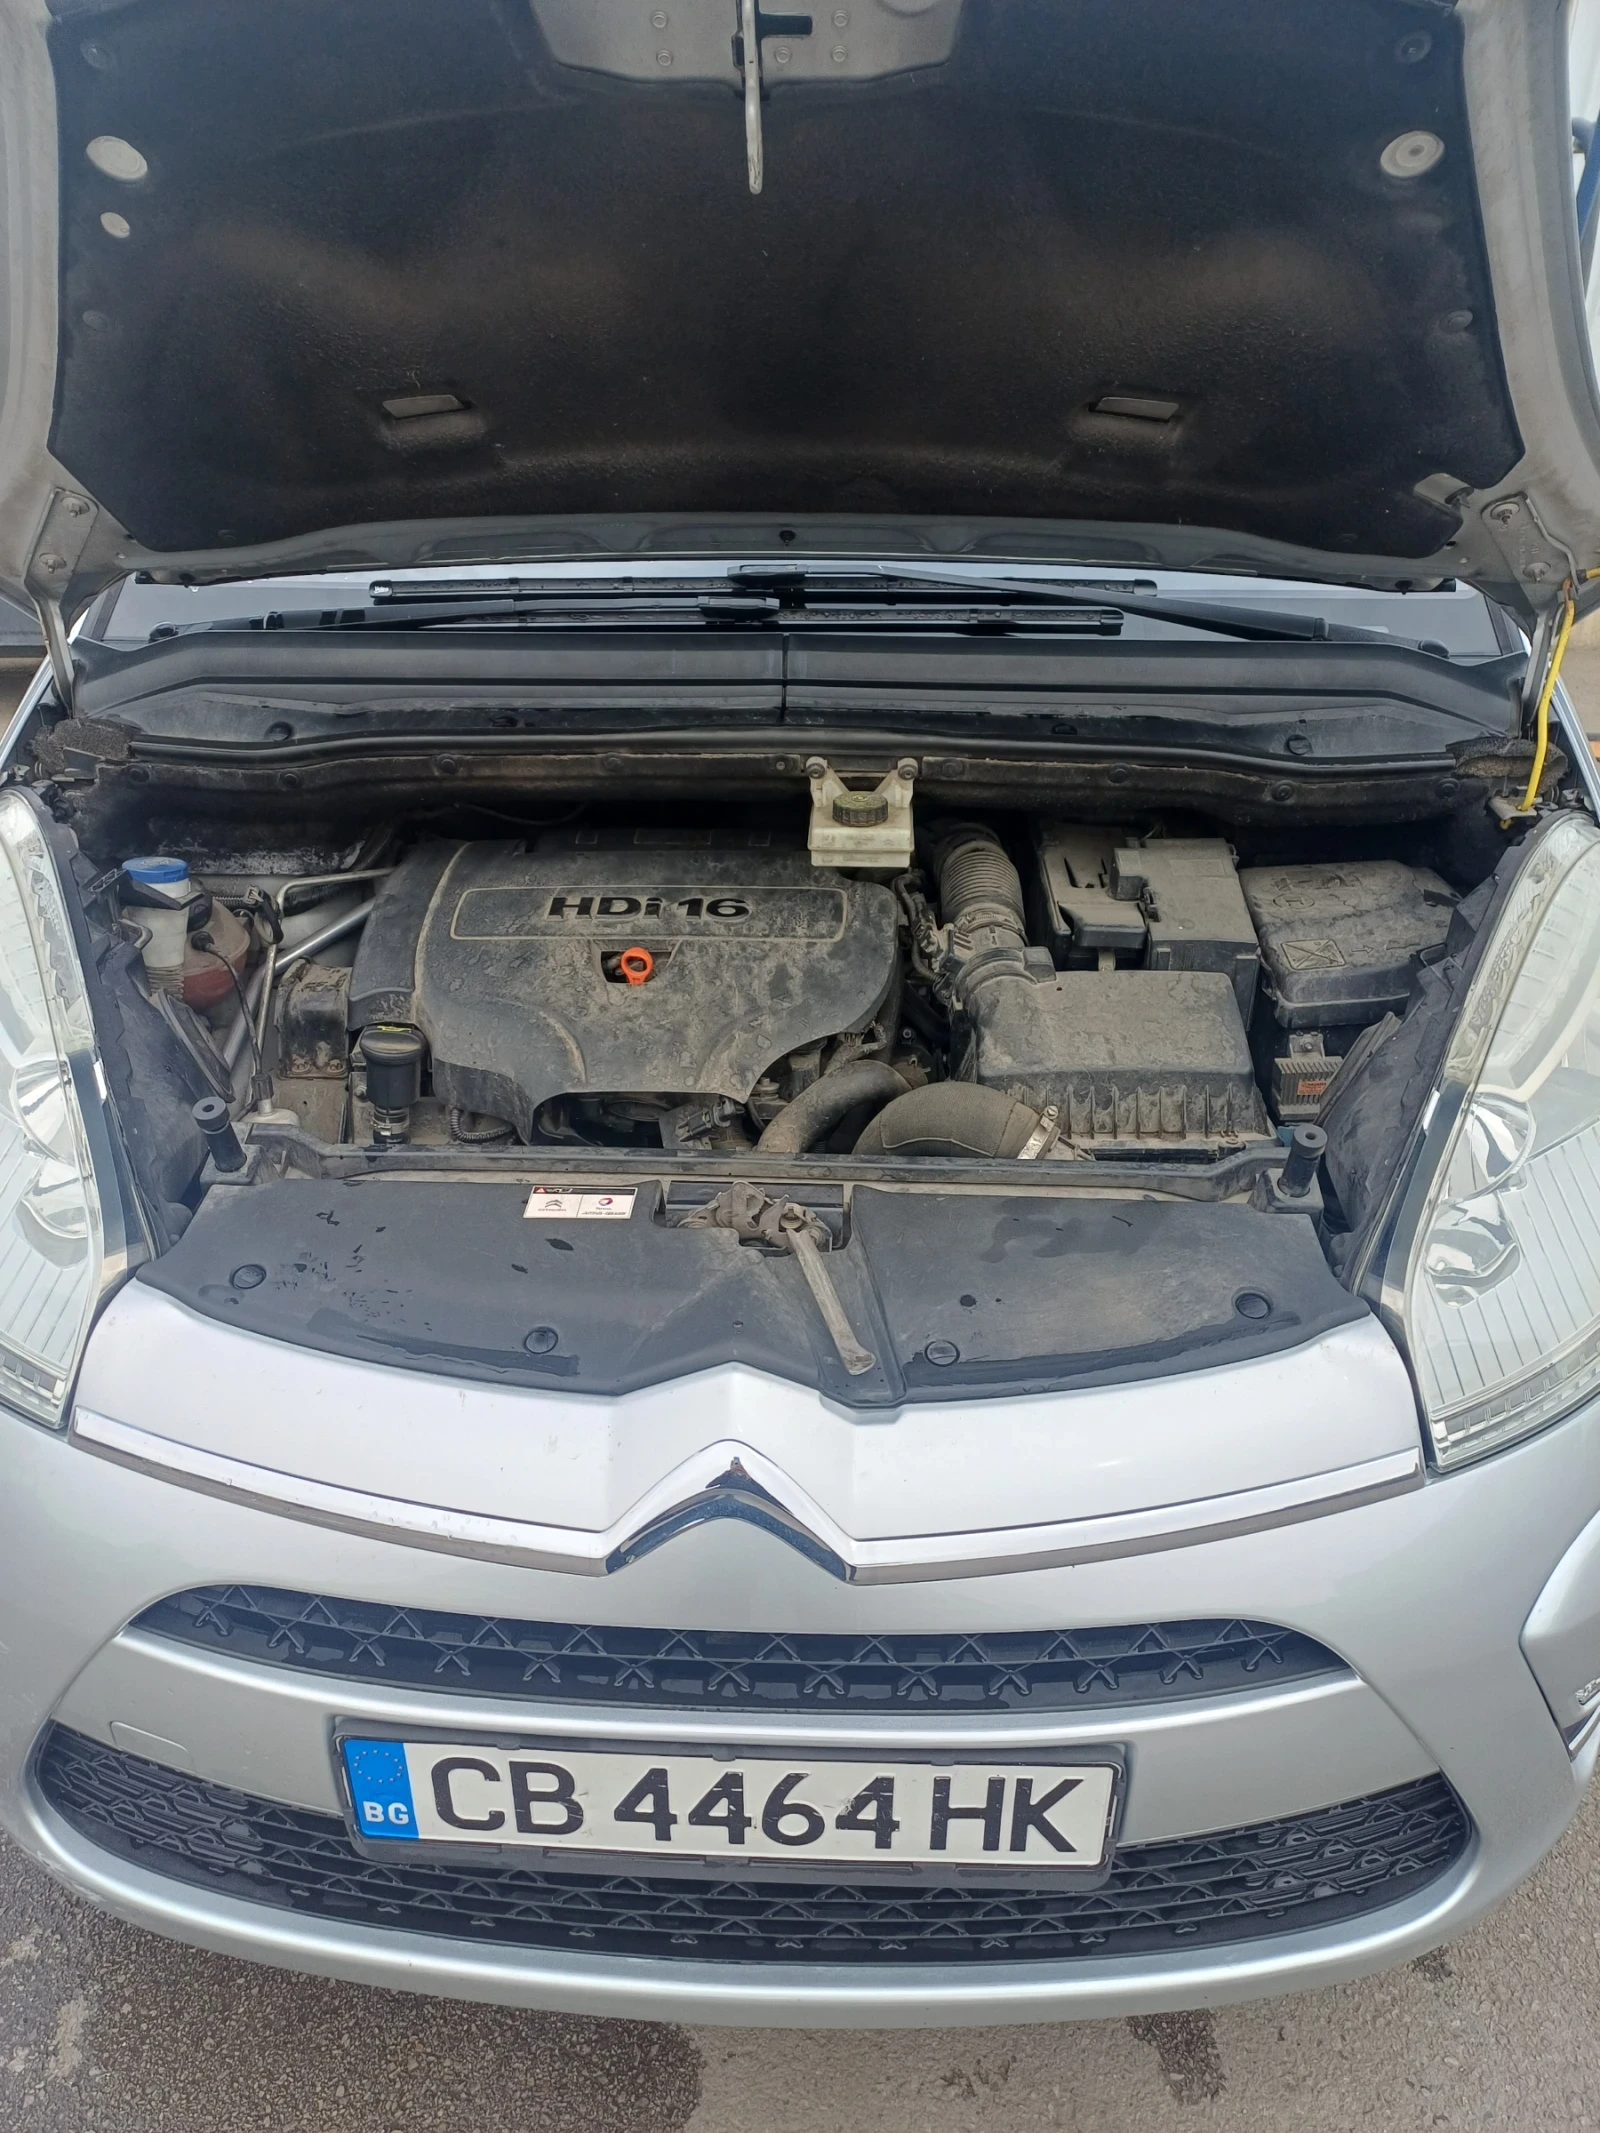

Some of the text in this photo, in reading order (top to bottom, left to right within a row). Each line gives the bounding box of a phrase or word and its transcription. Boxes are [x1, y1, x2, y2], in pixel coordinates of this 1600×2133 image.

[548, 896, 750, 919] HDi 16
[363, 1800, 410, 1825] BG
[431, 1756, 1085, 1853] CB 4464 HK
